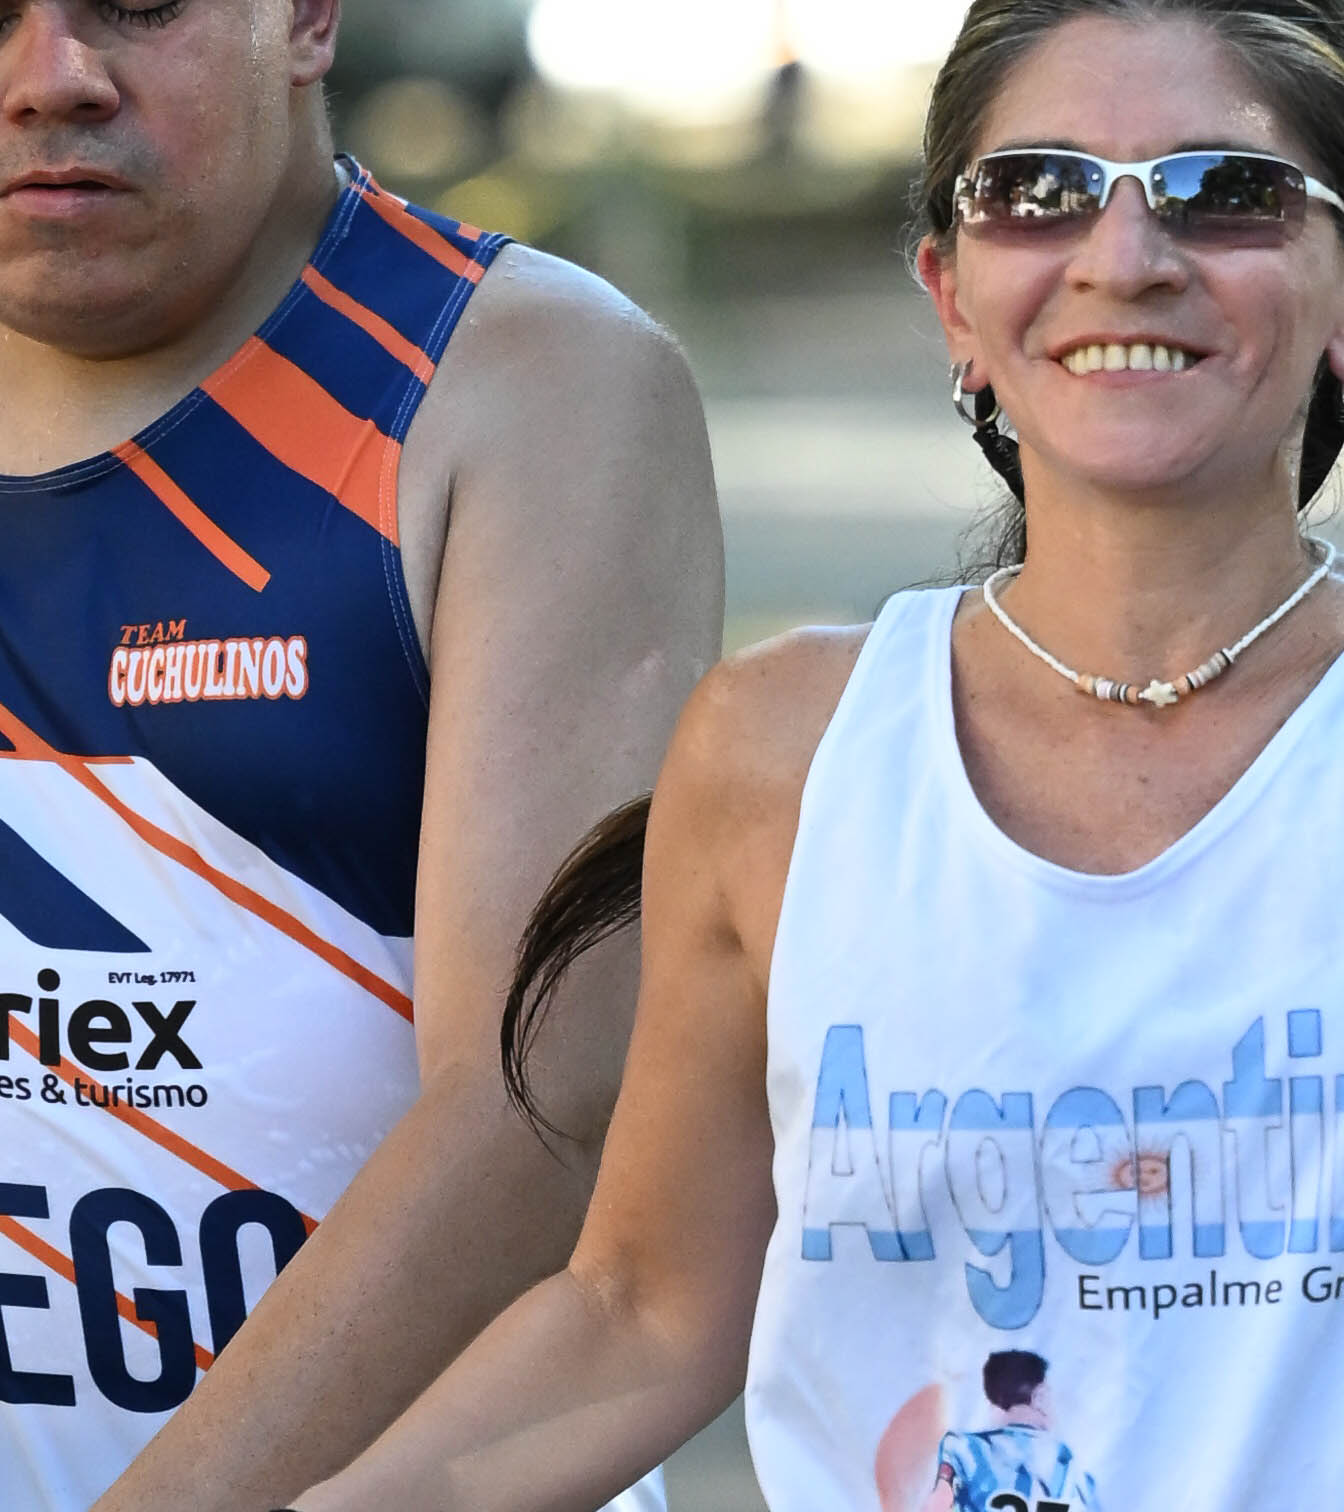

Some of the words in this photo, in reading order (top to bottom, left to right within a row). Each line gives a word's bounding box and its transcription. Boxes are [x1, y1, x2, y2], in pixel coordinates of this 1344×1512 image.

[120, 619, 187, 645] TEAM
[109, 636, 308, 706] CUCHULINOS
[108, 972, 132, 983] EVT
[159, 971, 196, 983] 17971
[41, 1074, 67, 1105] &
[74, 1077, 208, 1109] turismo
[1078, 1270, 1282, 1320] Empalme
